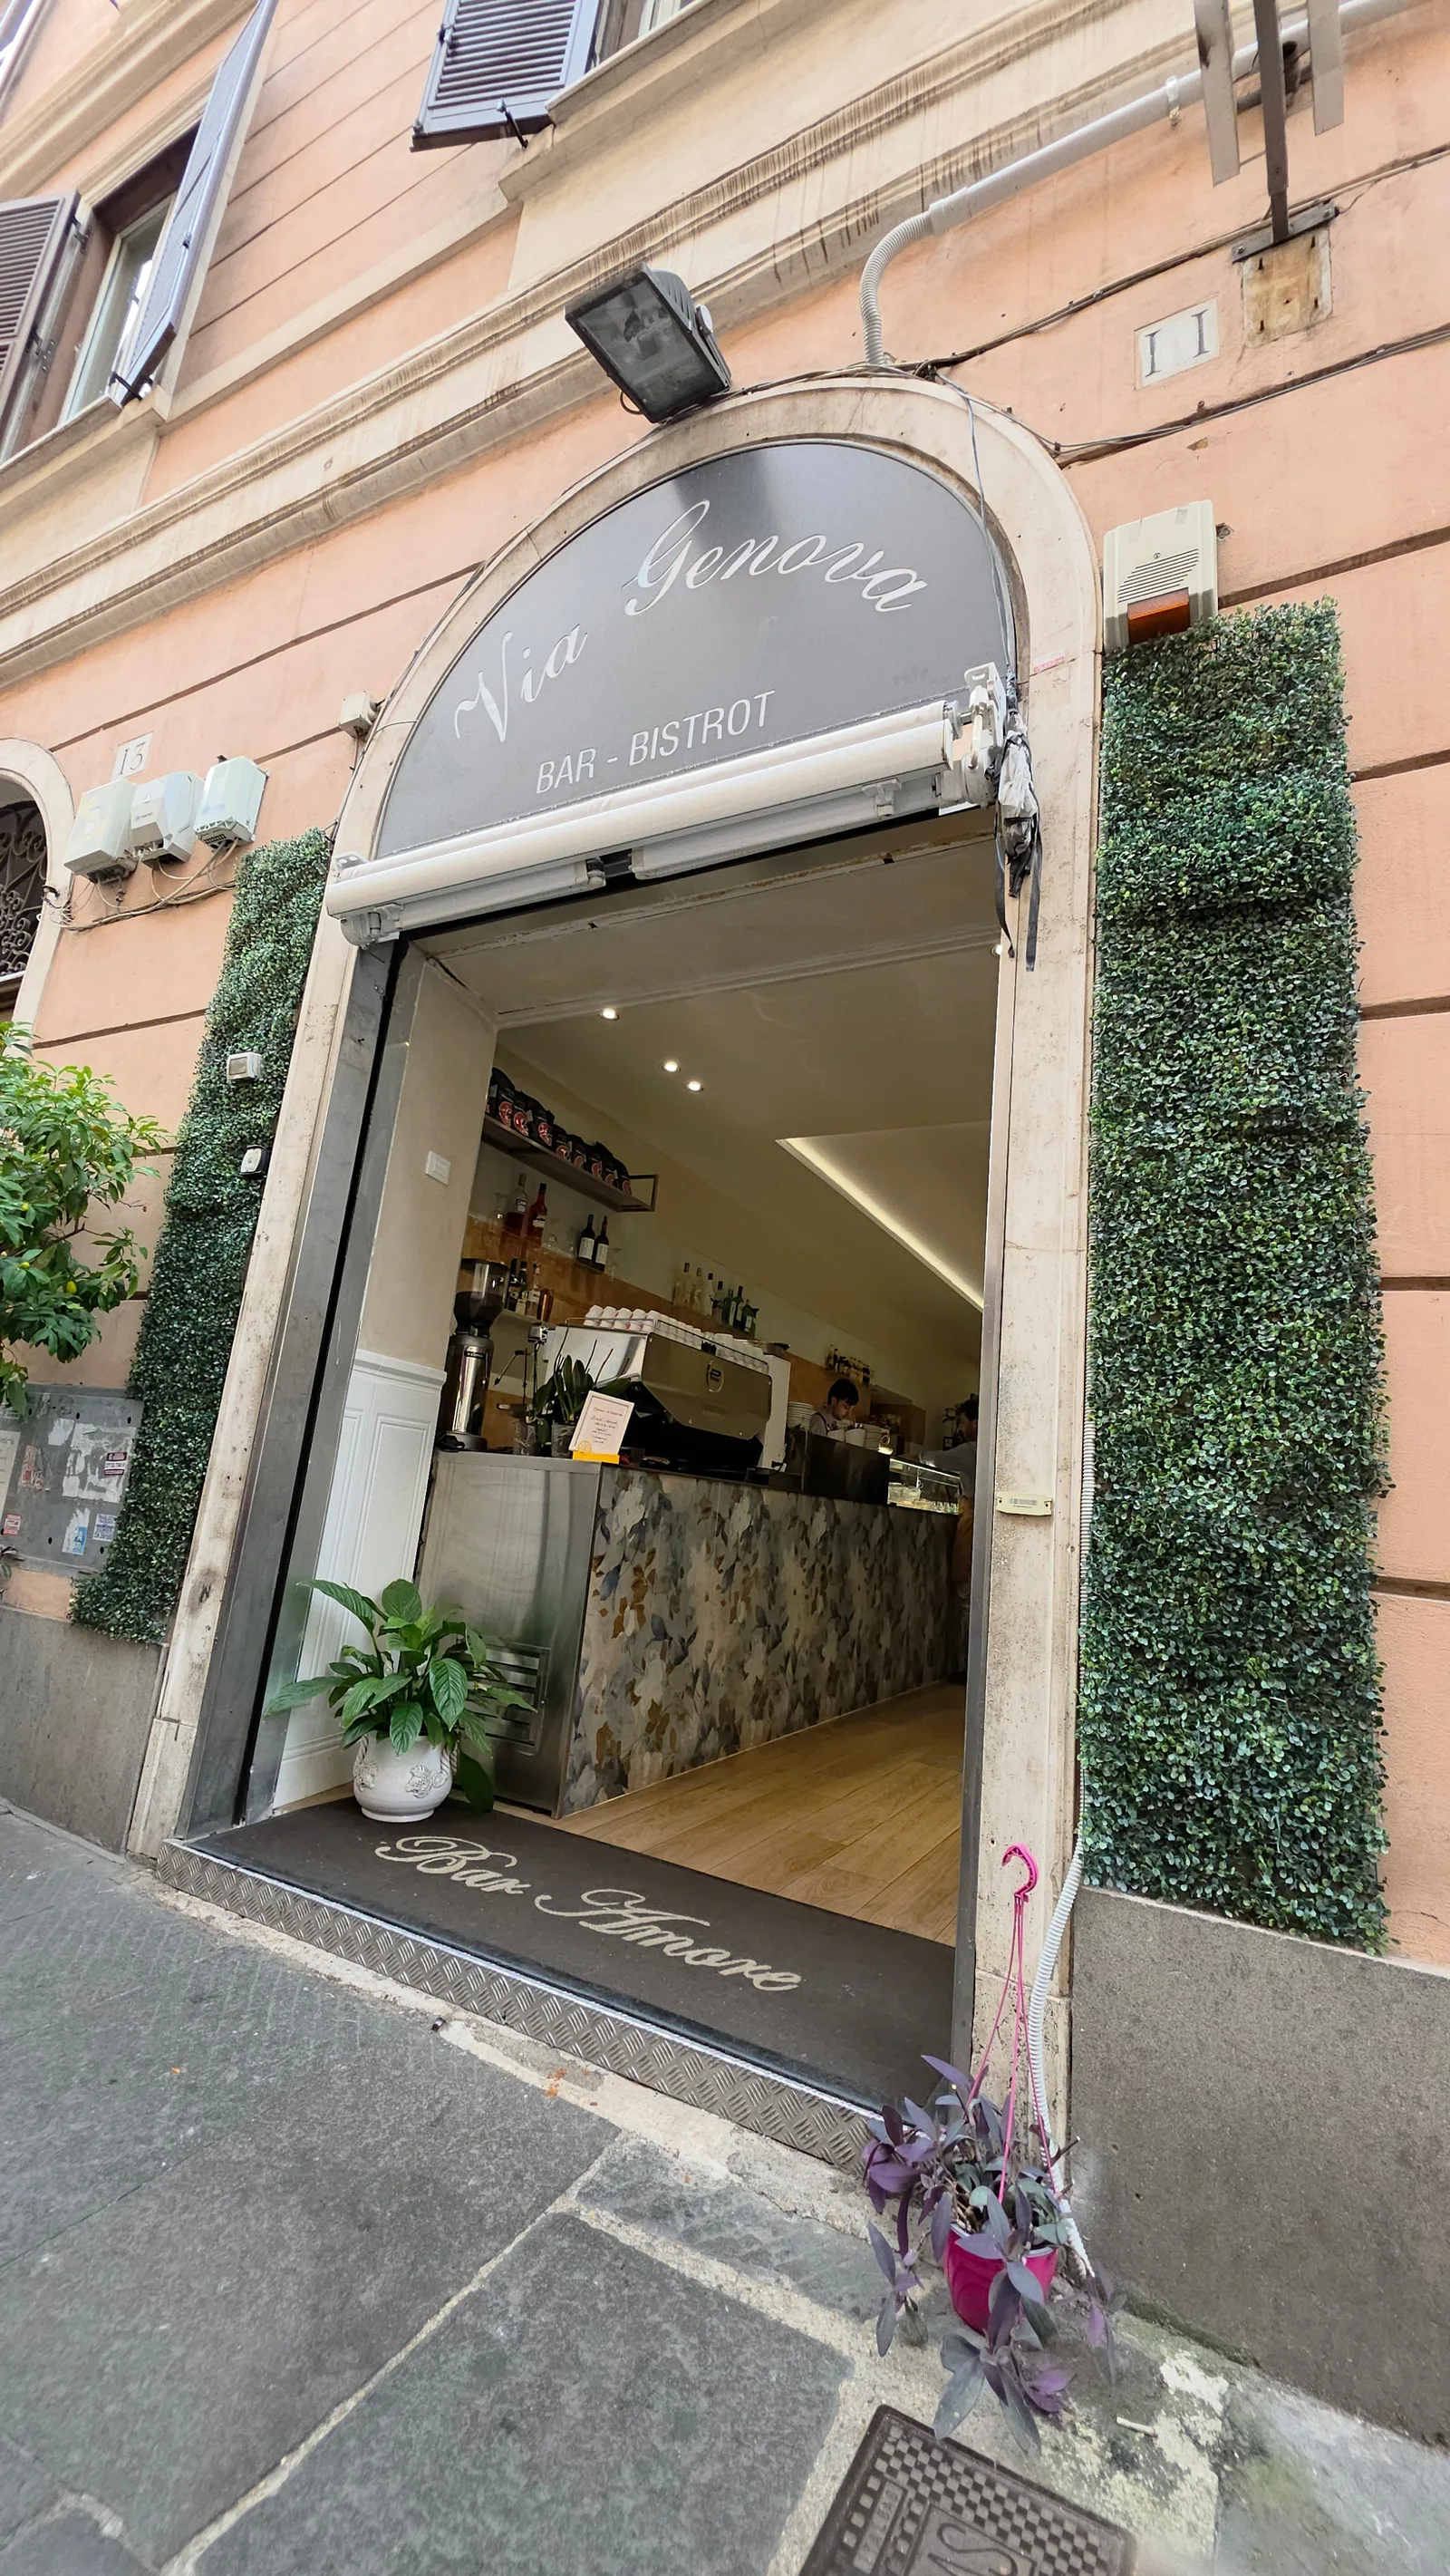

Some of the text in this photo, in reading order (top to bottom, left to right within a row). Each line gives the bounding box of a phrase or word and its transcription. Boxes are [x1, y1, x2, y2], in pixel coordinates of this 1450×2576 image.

[455, 499, 928, 743] Via Genova
[120, 741, 146, 775] 13
[535, 747, 597, 795] BAR
[628, 690, 776, 767] BISTROT
[374, 1835, 802, 1991] Bar Amore
